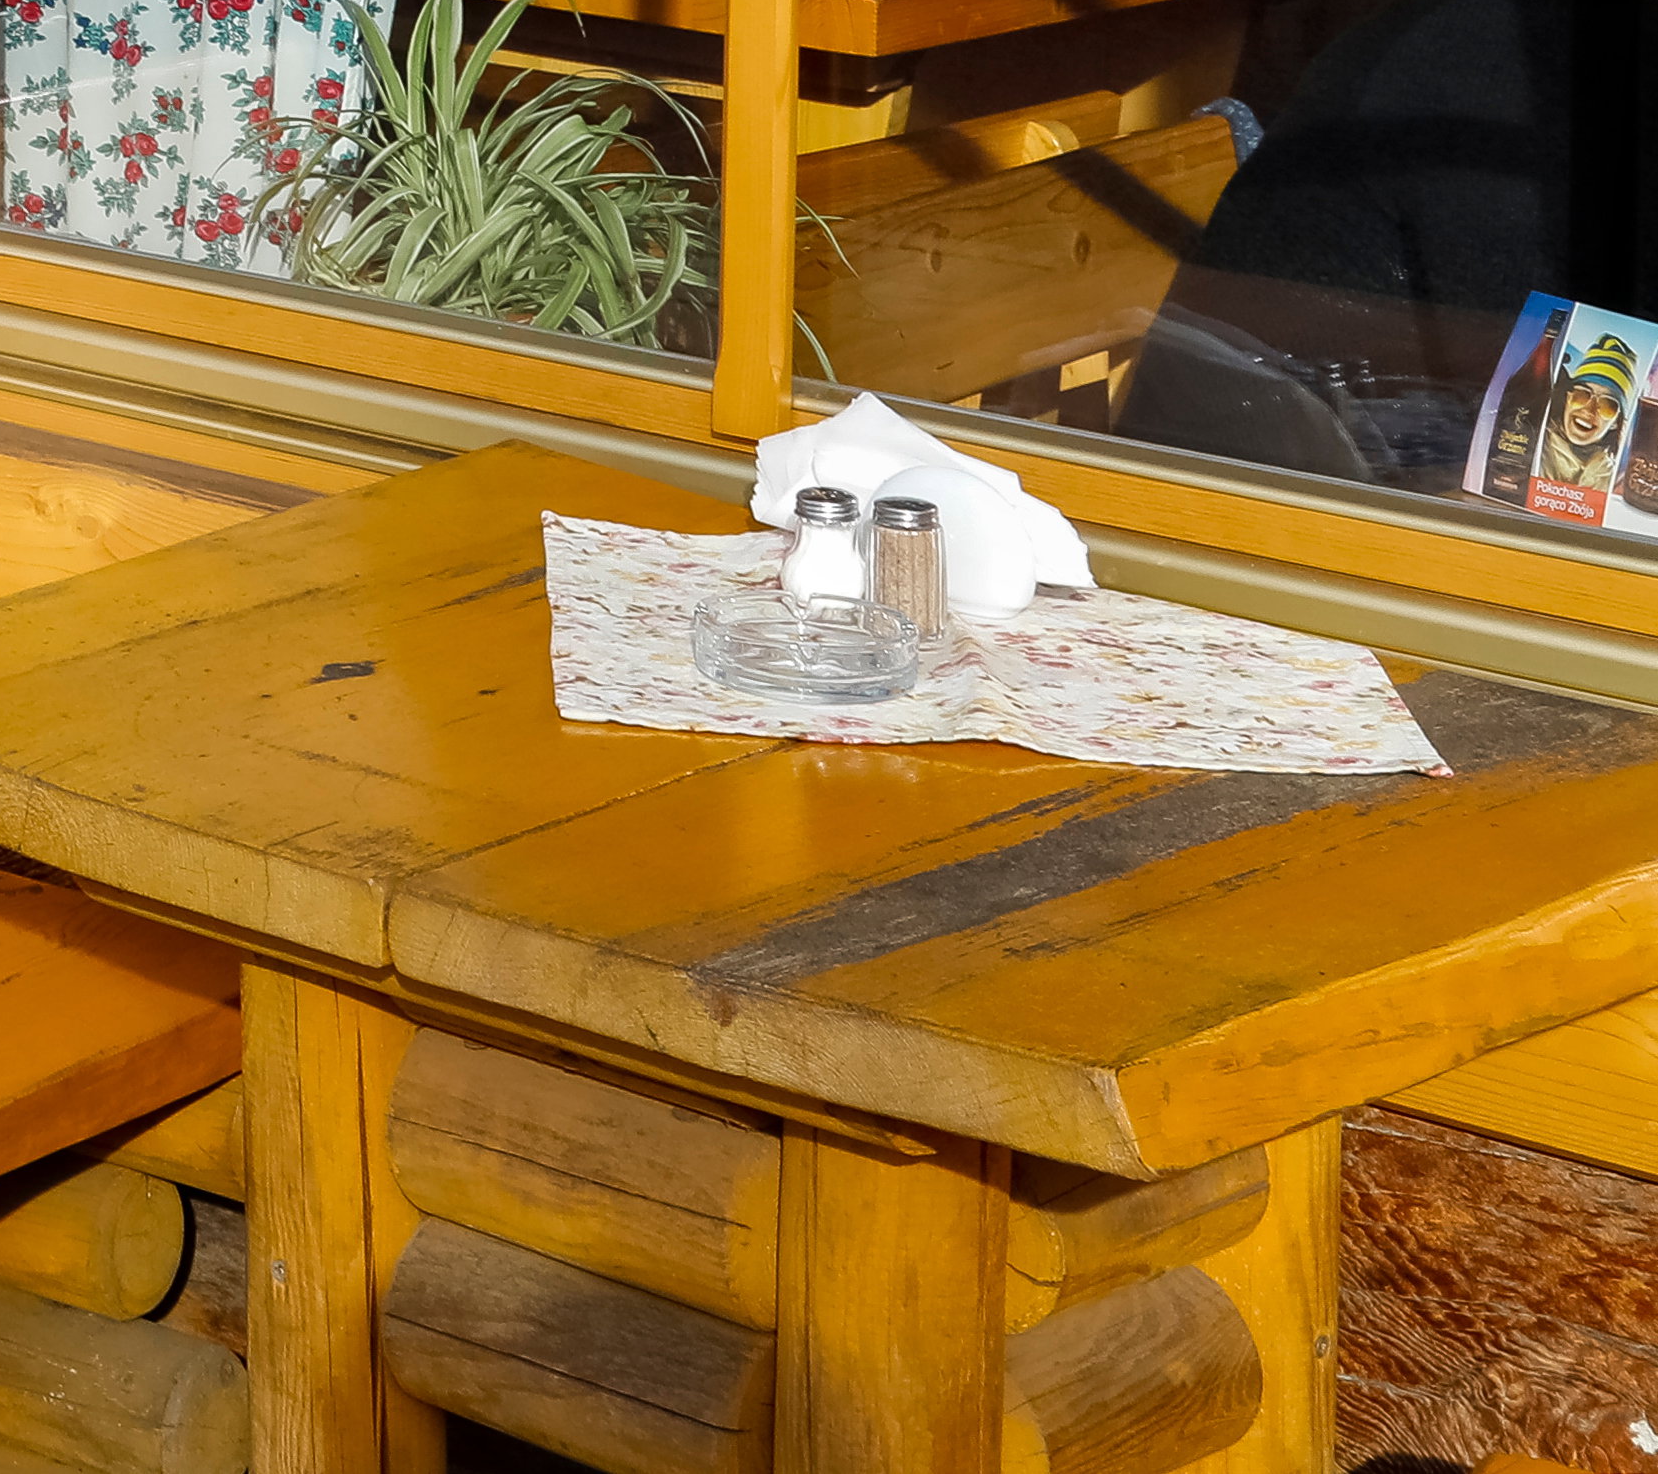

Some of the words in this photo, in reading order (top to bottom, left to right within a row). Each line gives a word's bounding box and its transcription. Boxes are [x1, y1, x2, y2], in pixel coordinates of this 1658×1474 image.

[1536, 480, 1585, 500] Pokochasz
[1533, 495, 1567, 512] gorąco
[1567, 501, 1596, 520] Zbója
